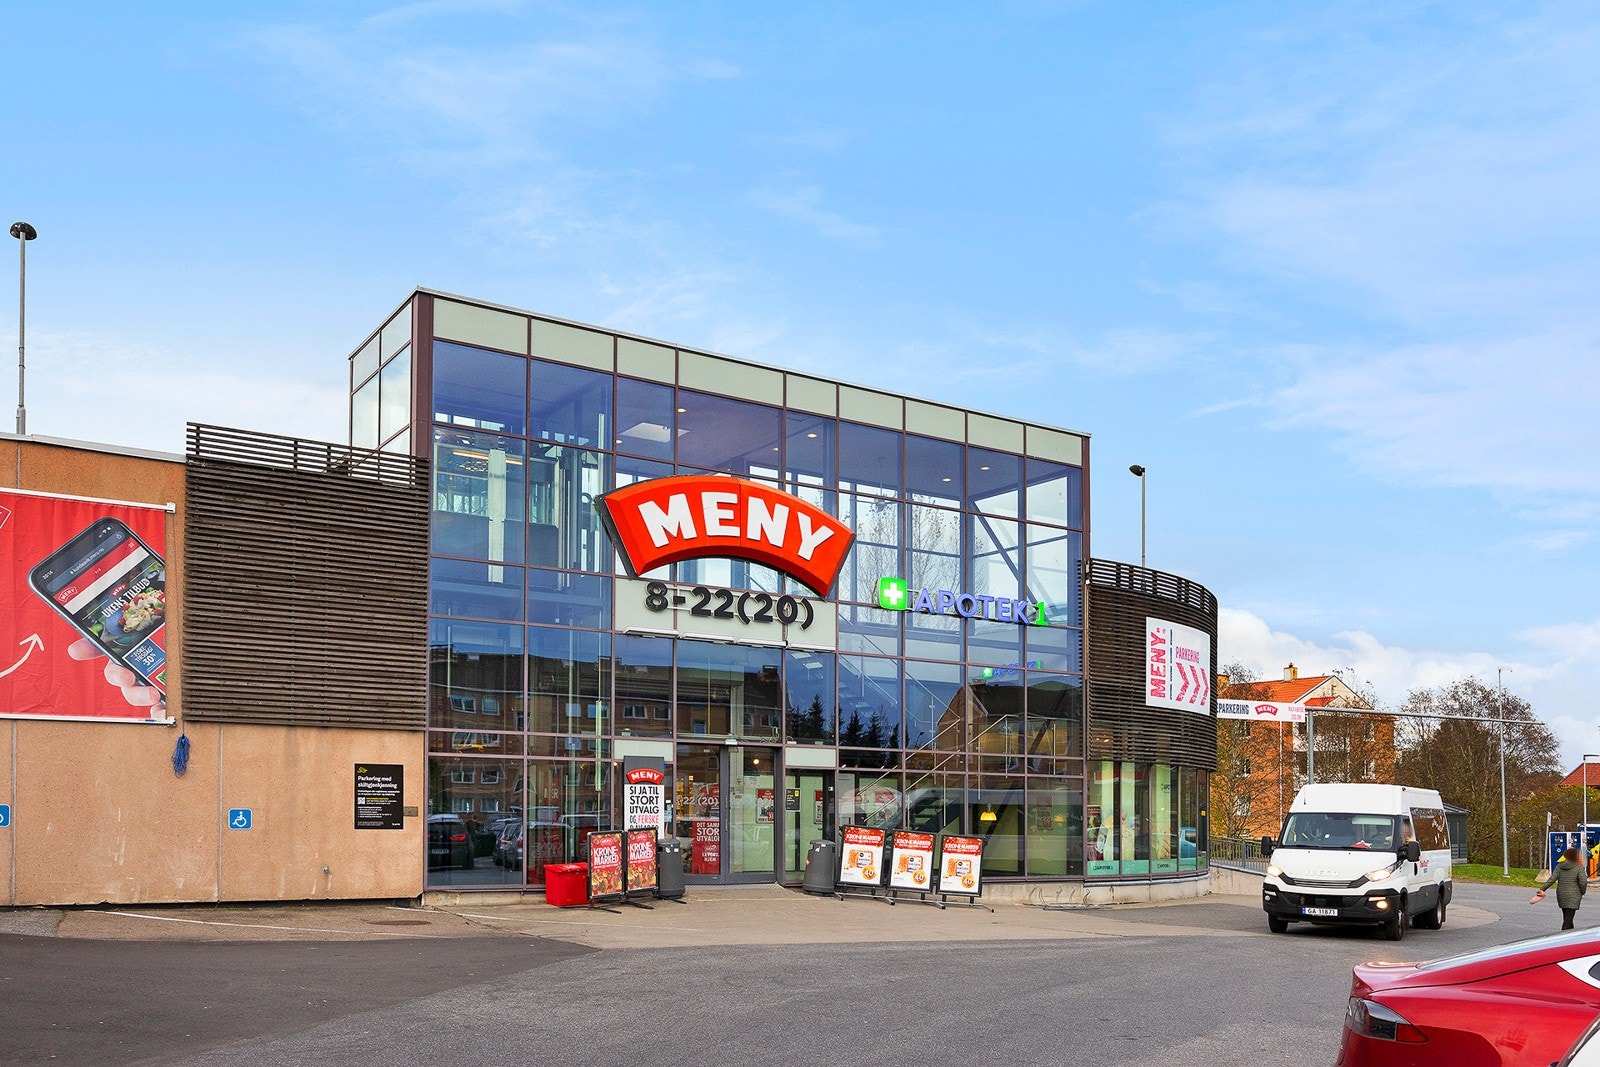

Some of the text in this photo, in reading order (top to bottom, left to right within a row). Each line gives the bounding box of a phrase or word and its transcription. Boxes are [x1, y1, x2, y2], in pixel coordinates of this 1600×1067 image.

[638, 491, 834, 561] MENY
[101, 577, 151, 618] UKENS TILBUD
[914, 587, 1048, 626] APOTEK 1
[1176, 646, 1199, 664] PARKERING
[1256, 705, 1277, 716] MENY
[631, 771, 660, 781] MENY
[629, 786, 659, 795] SI JA TIL
[629, 795, 659, 805] STORT
[629, 806, 659, 814] UTVALG
[629, 815, 659, 824] OG FERSKE
[593, 854, 619, 866] MARKED
[630, 850, 653, 861] MARKED
[1304, 869, 1339, 877] IVECO
